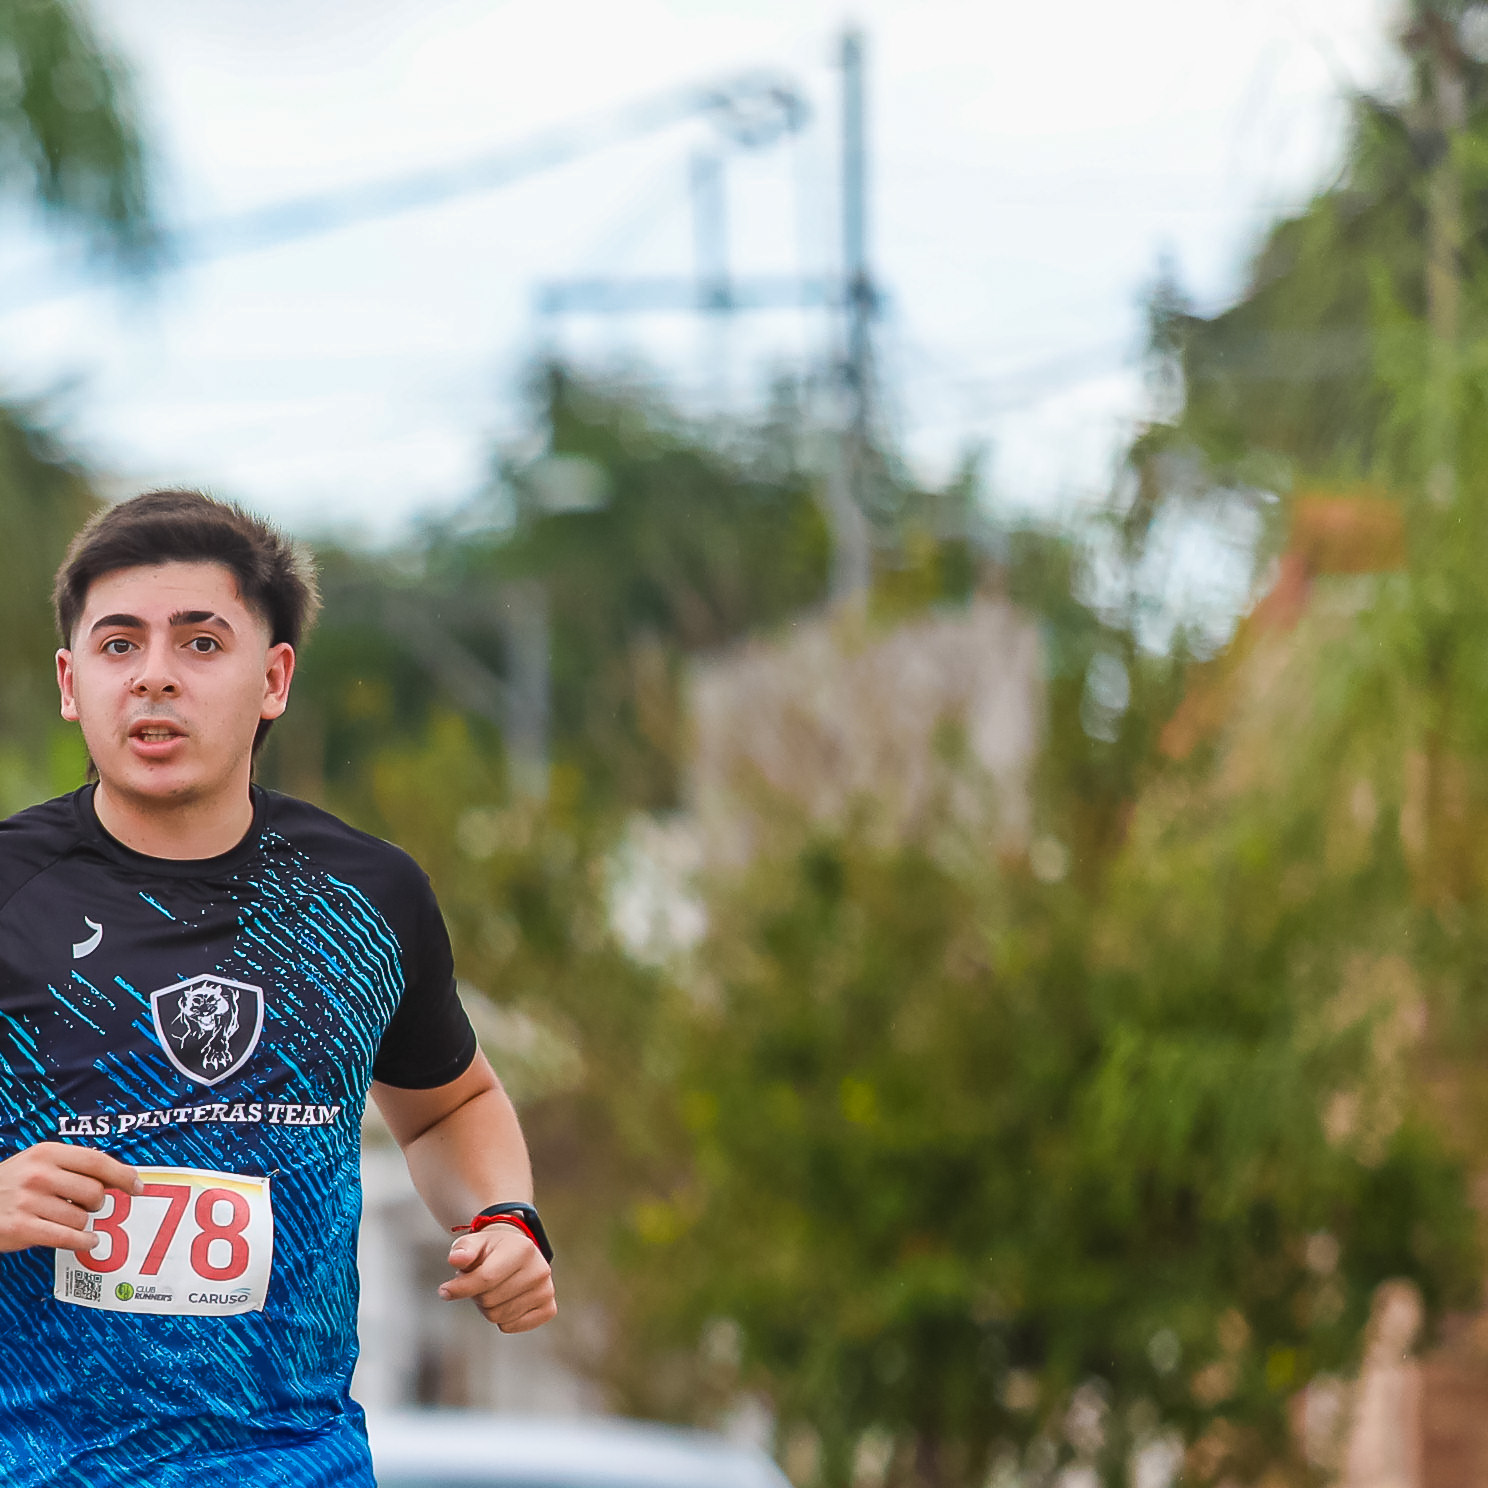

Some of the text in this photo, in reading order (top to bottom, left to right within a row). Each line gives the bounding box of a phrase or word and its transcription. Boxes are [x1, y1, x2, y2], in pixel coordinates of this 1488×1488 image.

[58, 1103, 341, 1136] LAS PANTERAS TEAM
[74, 1183, 251, 1281] 378
[136, 1285, 157, 1294] CLUB
[188, 1291, 248, 1305] CARUSO
